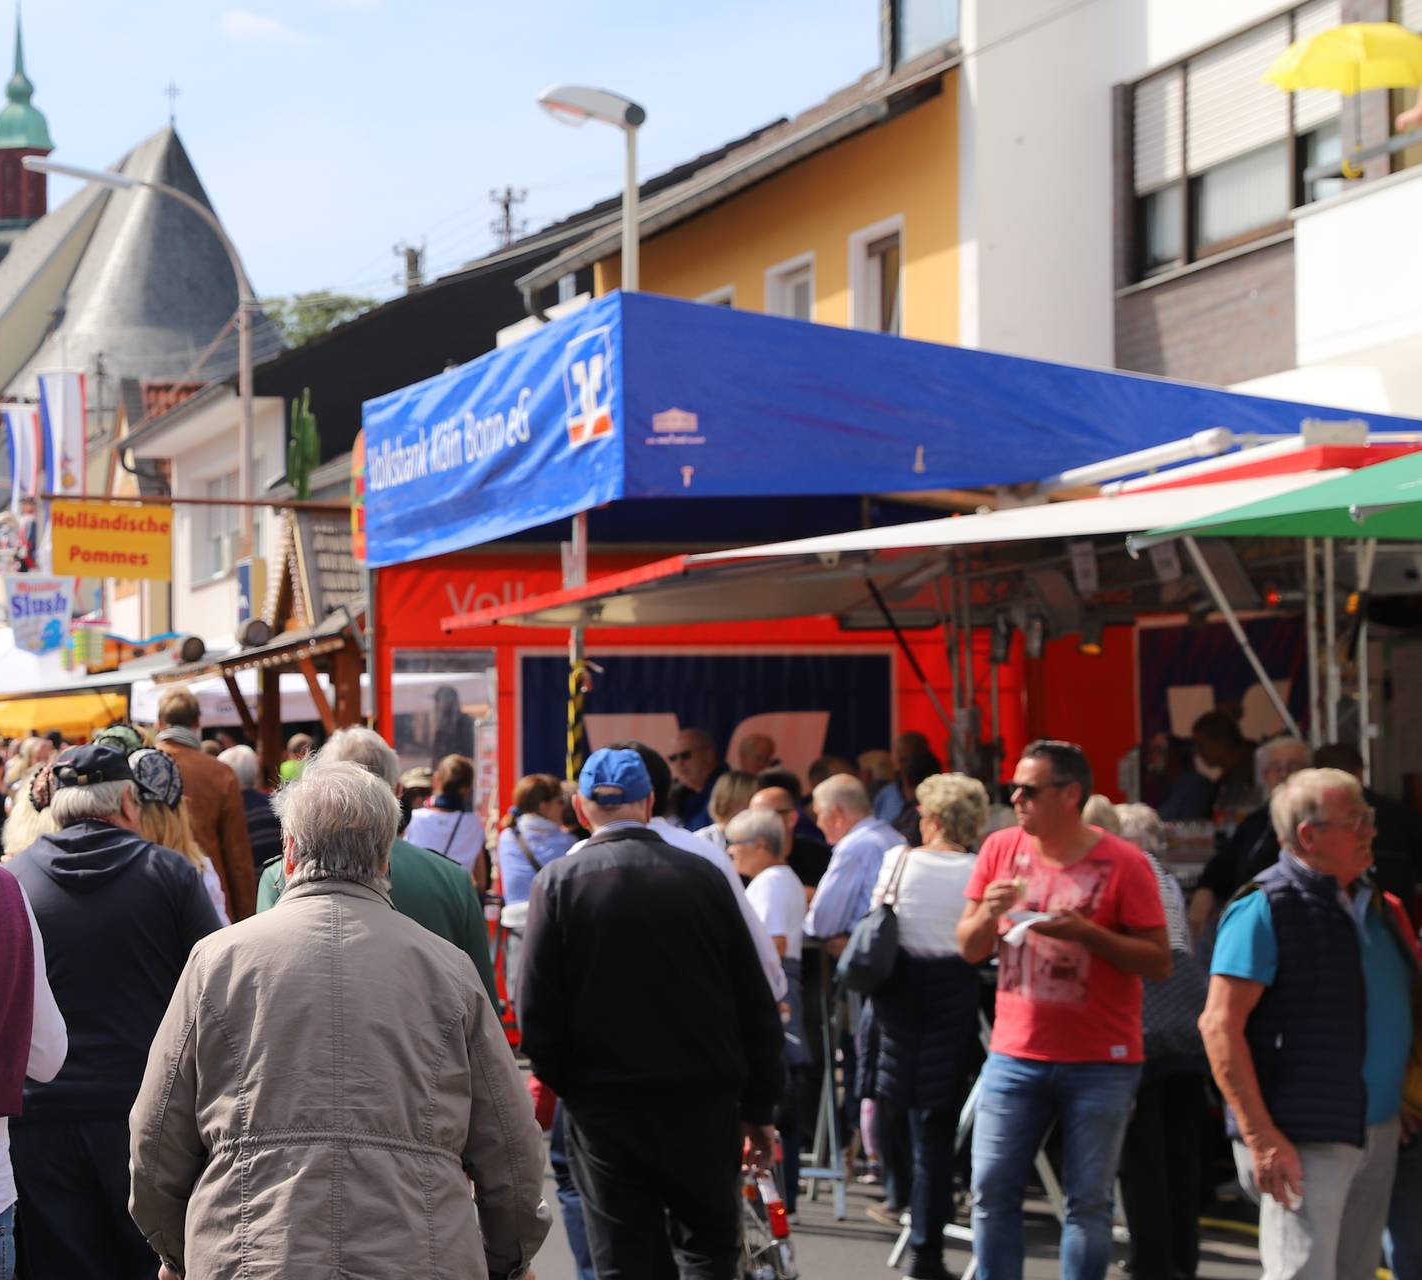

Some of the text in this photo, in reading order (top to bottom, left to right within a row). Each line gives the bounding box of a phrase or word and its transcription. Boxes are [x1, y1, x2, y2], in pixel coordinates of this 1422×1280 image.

[52, 511, 171, 534] Holländische
[69, 545, 149, 567] Pommes
[10, 592, 68, 619] Slush
